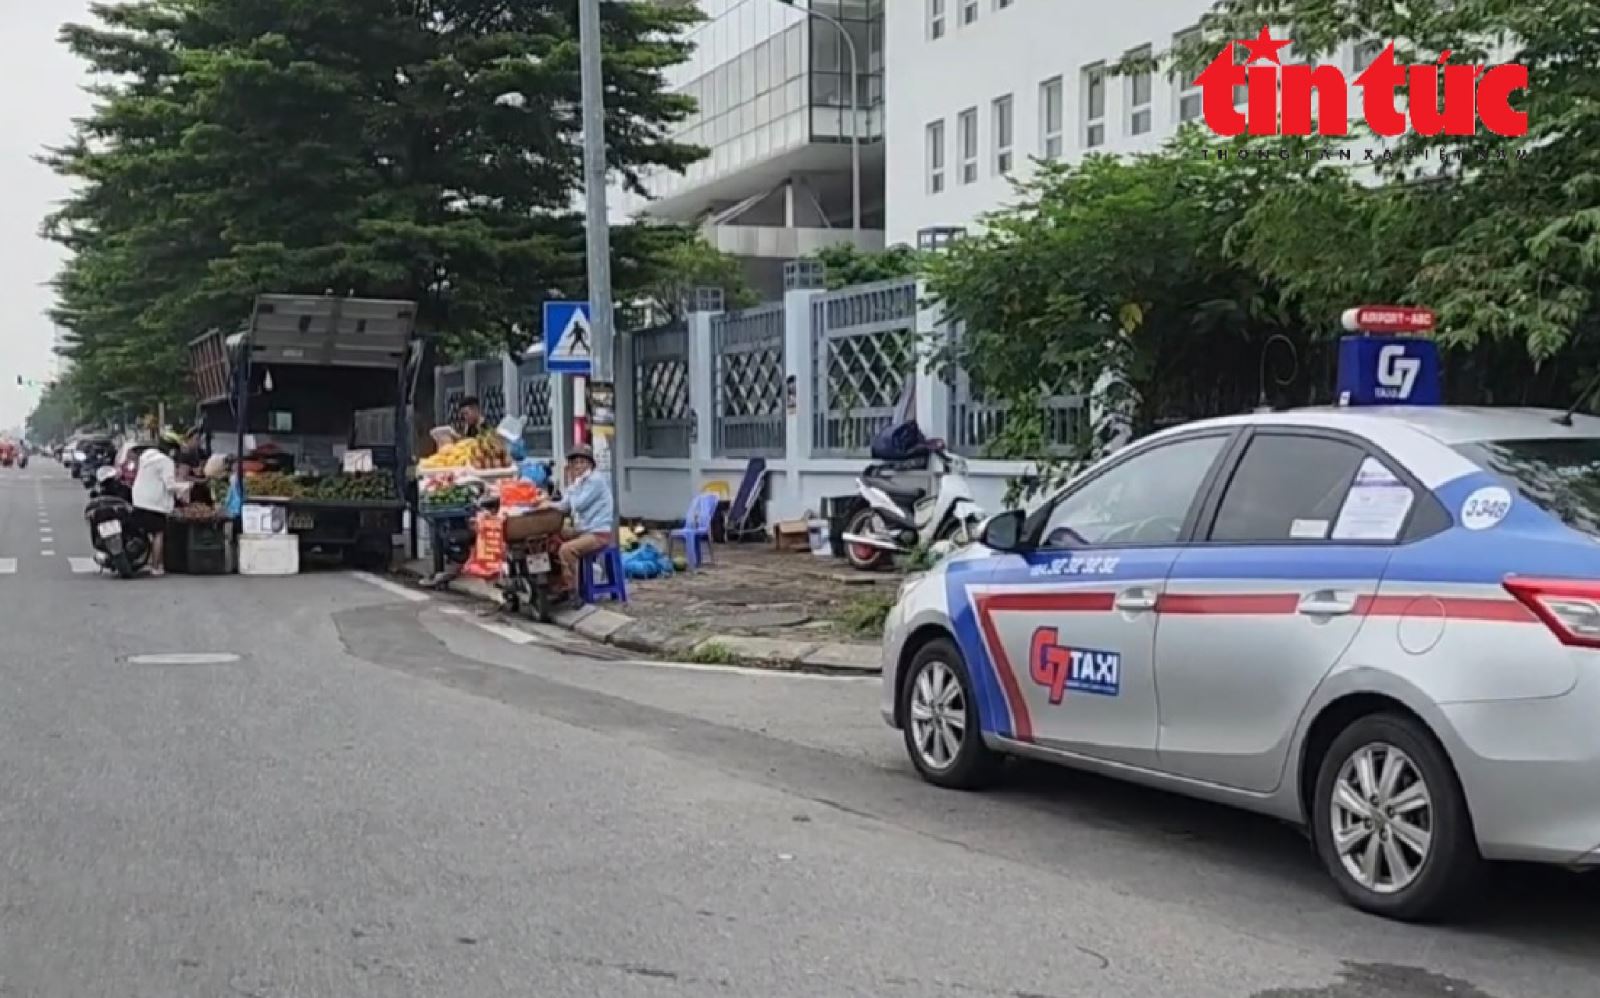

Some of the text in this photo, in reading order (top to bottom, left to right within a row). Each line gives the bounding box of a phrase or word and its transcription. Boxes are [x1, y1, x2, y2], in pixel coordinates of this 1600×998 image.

[1378, 345, 1421, 399] G7
[1029, 625, 1117, 706] G7 TAXI
